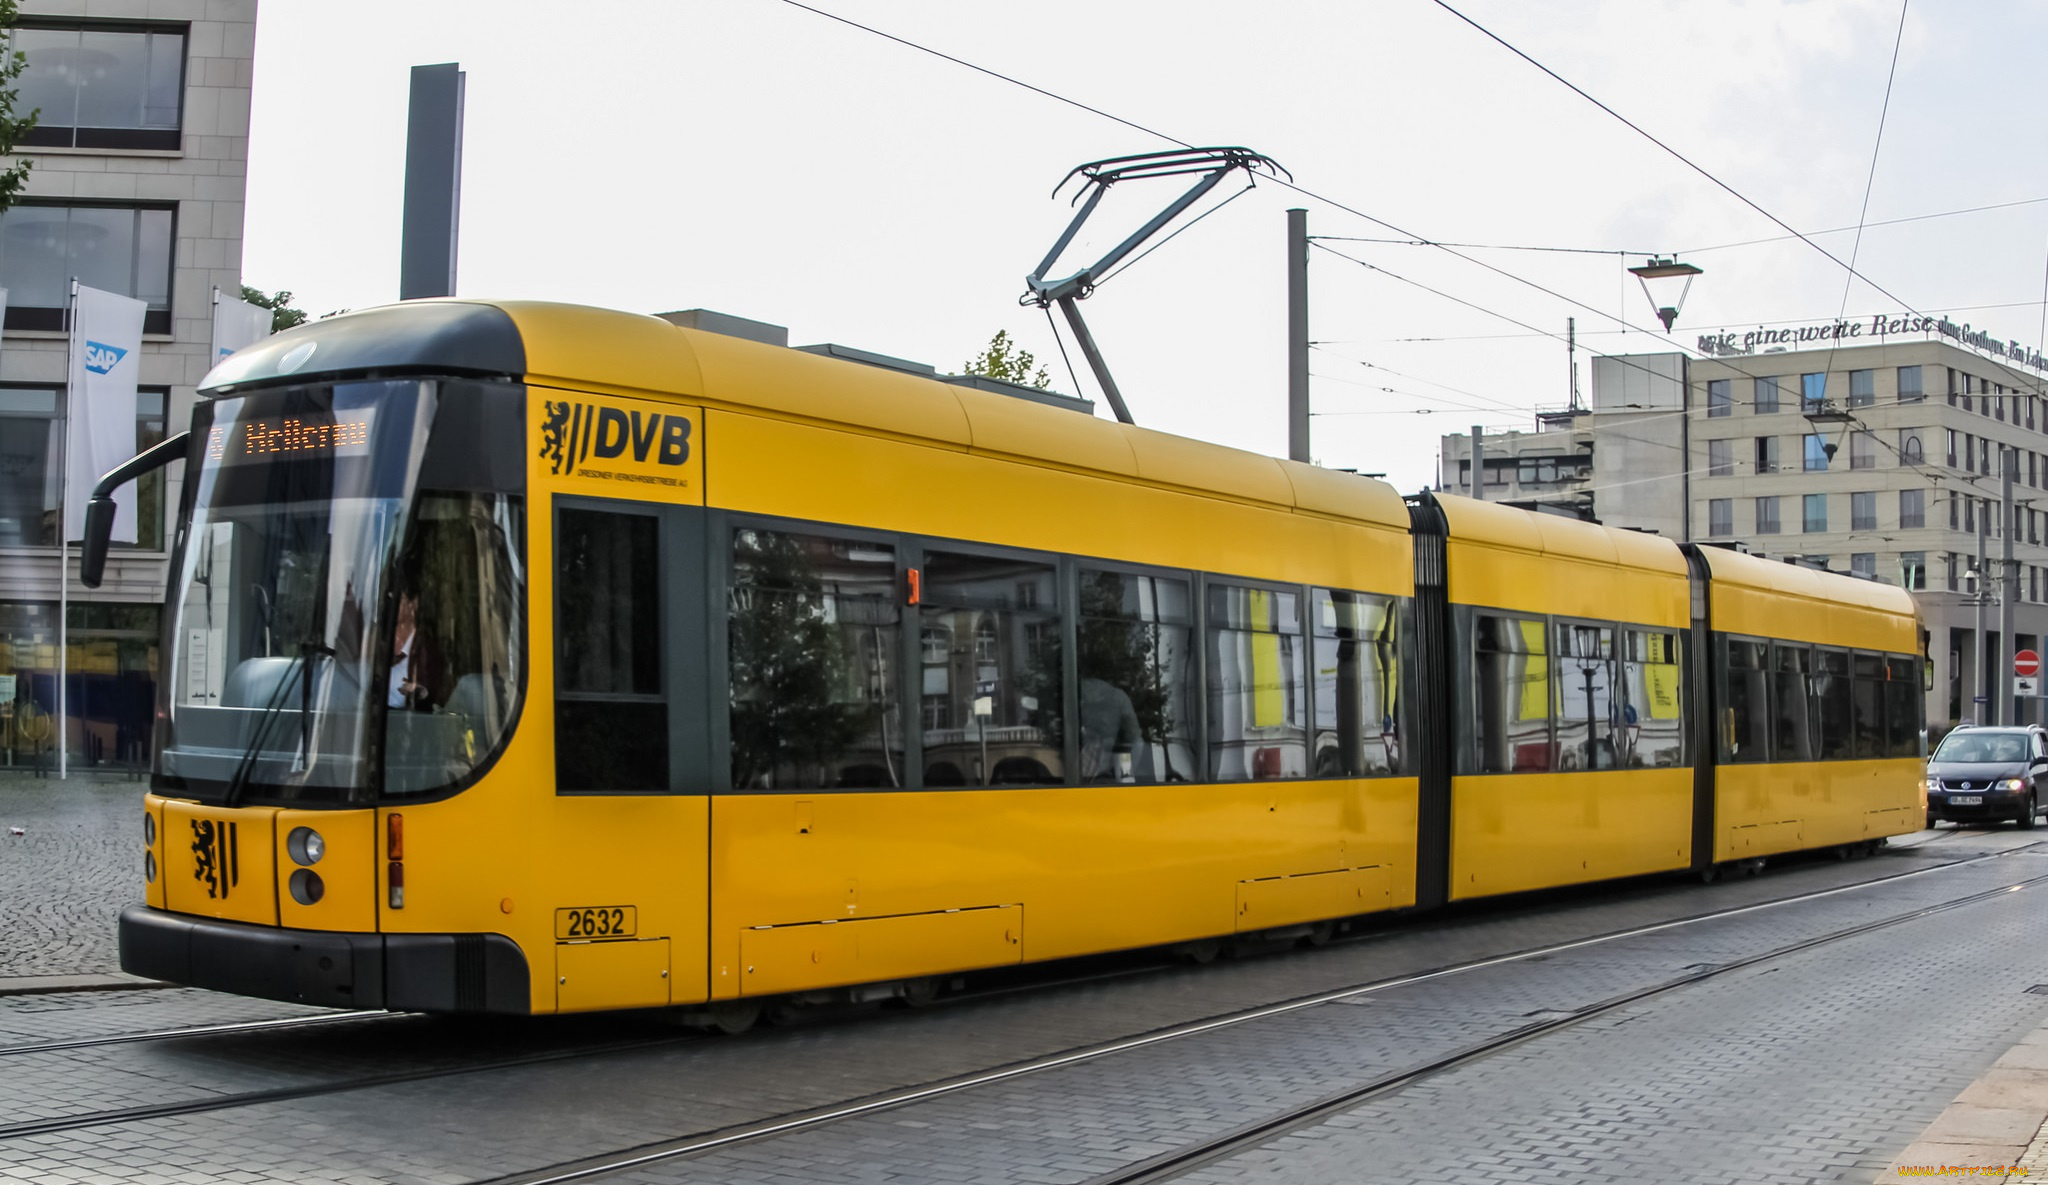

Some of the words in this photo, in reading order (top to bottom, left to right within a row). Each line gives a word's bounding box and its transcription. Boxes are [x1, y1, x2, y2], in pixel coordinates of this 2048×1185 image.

[1697, 328, 1736, 354] wie
[1744, 325, 1791, 347] eine
[1799, 318, 1862, 342] weite
[1868, 313, 1933, 337] Reise
[86, 345, 118, 370] SAP
[594, 407, 691, 466] DVB
[568, 908, 624, 936] 2632
